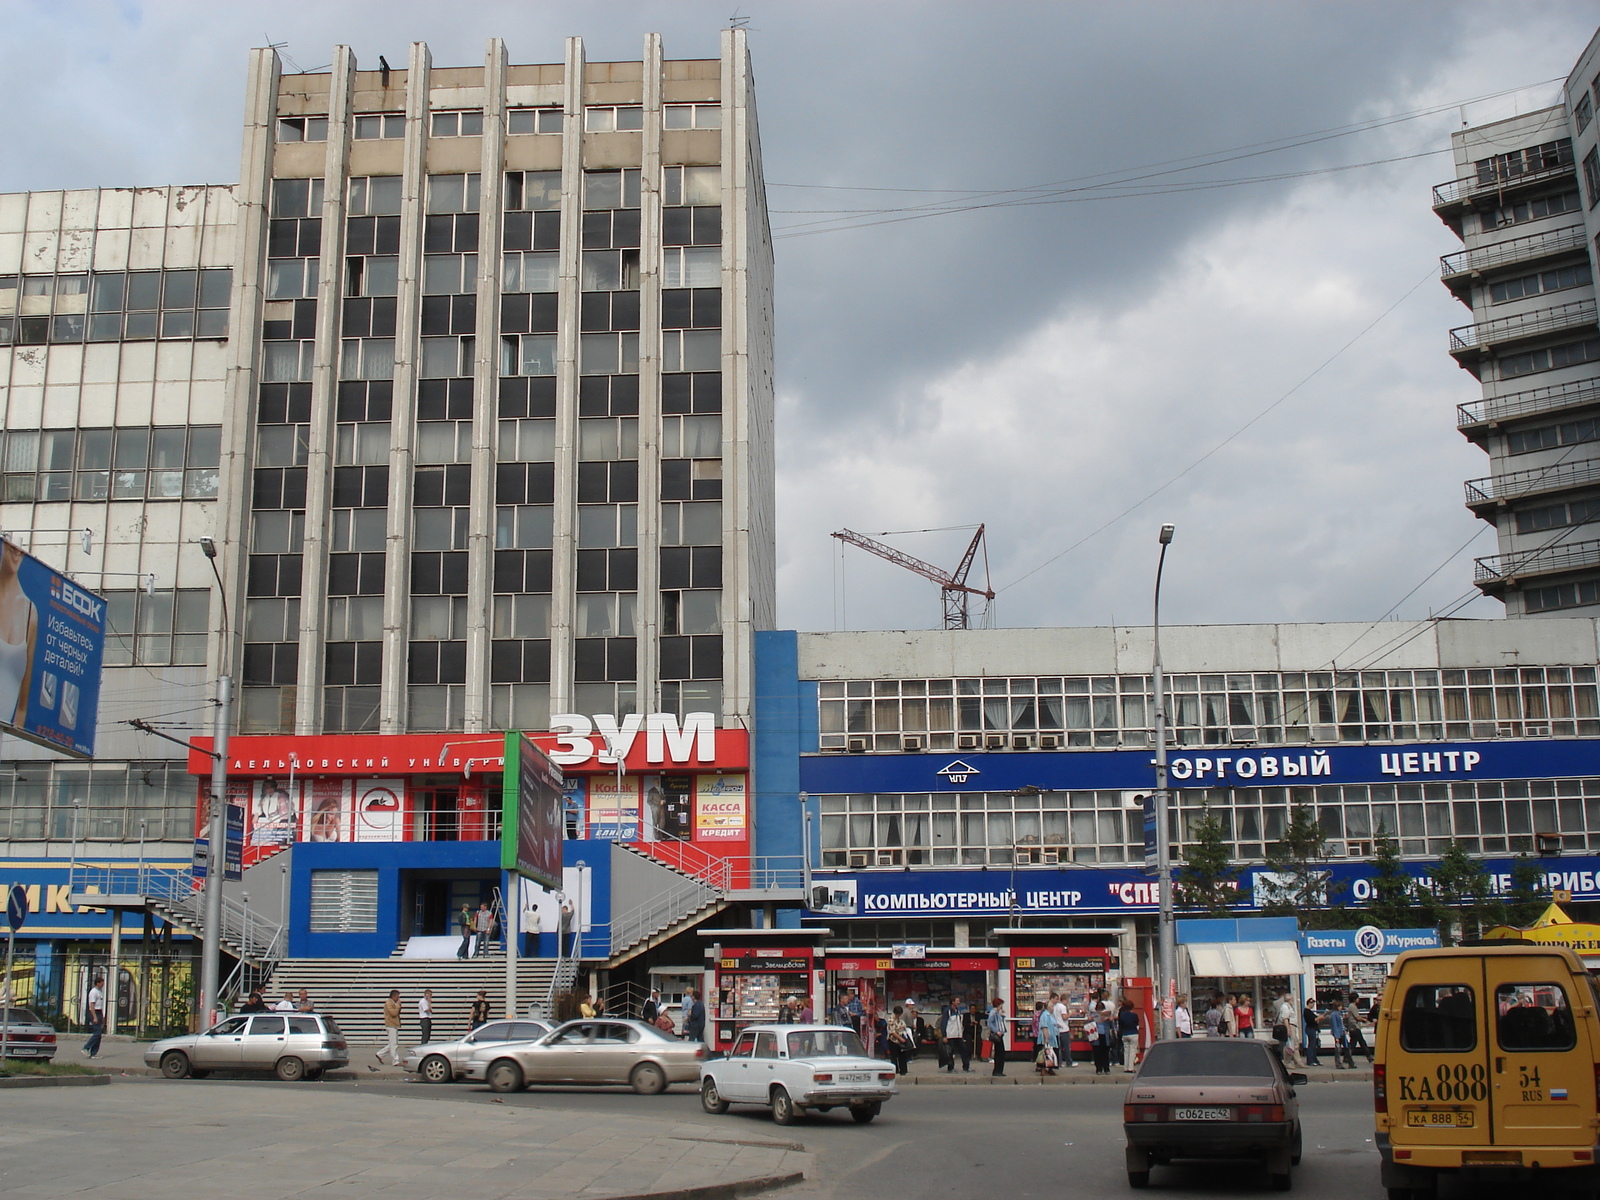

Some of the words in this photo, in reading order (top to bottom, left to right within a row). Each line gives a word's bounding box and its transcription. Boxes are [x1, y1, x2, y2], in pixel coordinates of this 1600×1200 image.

[62, 583, 102, 623] БФК
[47, 614, 94, 652] Избавьтесь
[46, 632, 57, 647] от
[58, 640, 88, 665] черных
[549, 711, 716, 765] ЗУМ
[234, 755, 389, 769] АЕЛЬЦОВСКИЙ
[1150, 749, 1331, 780] ОРГОВЫЙ
[1380, 750, 1482, 777] ЦЕНТР
[595, 783, 632, 793] Kodak
[702, 803, 741, 812] КАССА
[701, 829, 741, 837] КРЕДИТ
[1533, 870, 1600, 893] ПРИБ
[0, 884, 107, 913] ИКА
[864, 889, 1017, 910] КОМПЬЮТЕРНЫЙ
[1026, 891, 1082, 909] ЦЕНТР
[1307, 936, 1346, 949] Газеты
[1386, 934, 1437, 949] Журналы
[1519, 1065, 1541, 1088] 54
[1522, 1090, 1543, 1102] RUS
[1218, 1108, 1228, 1117] 42
[1431, 1113, 1452, 1124] 888
[1458, 1112, 1469, 1122] 54
